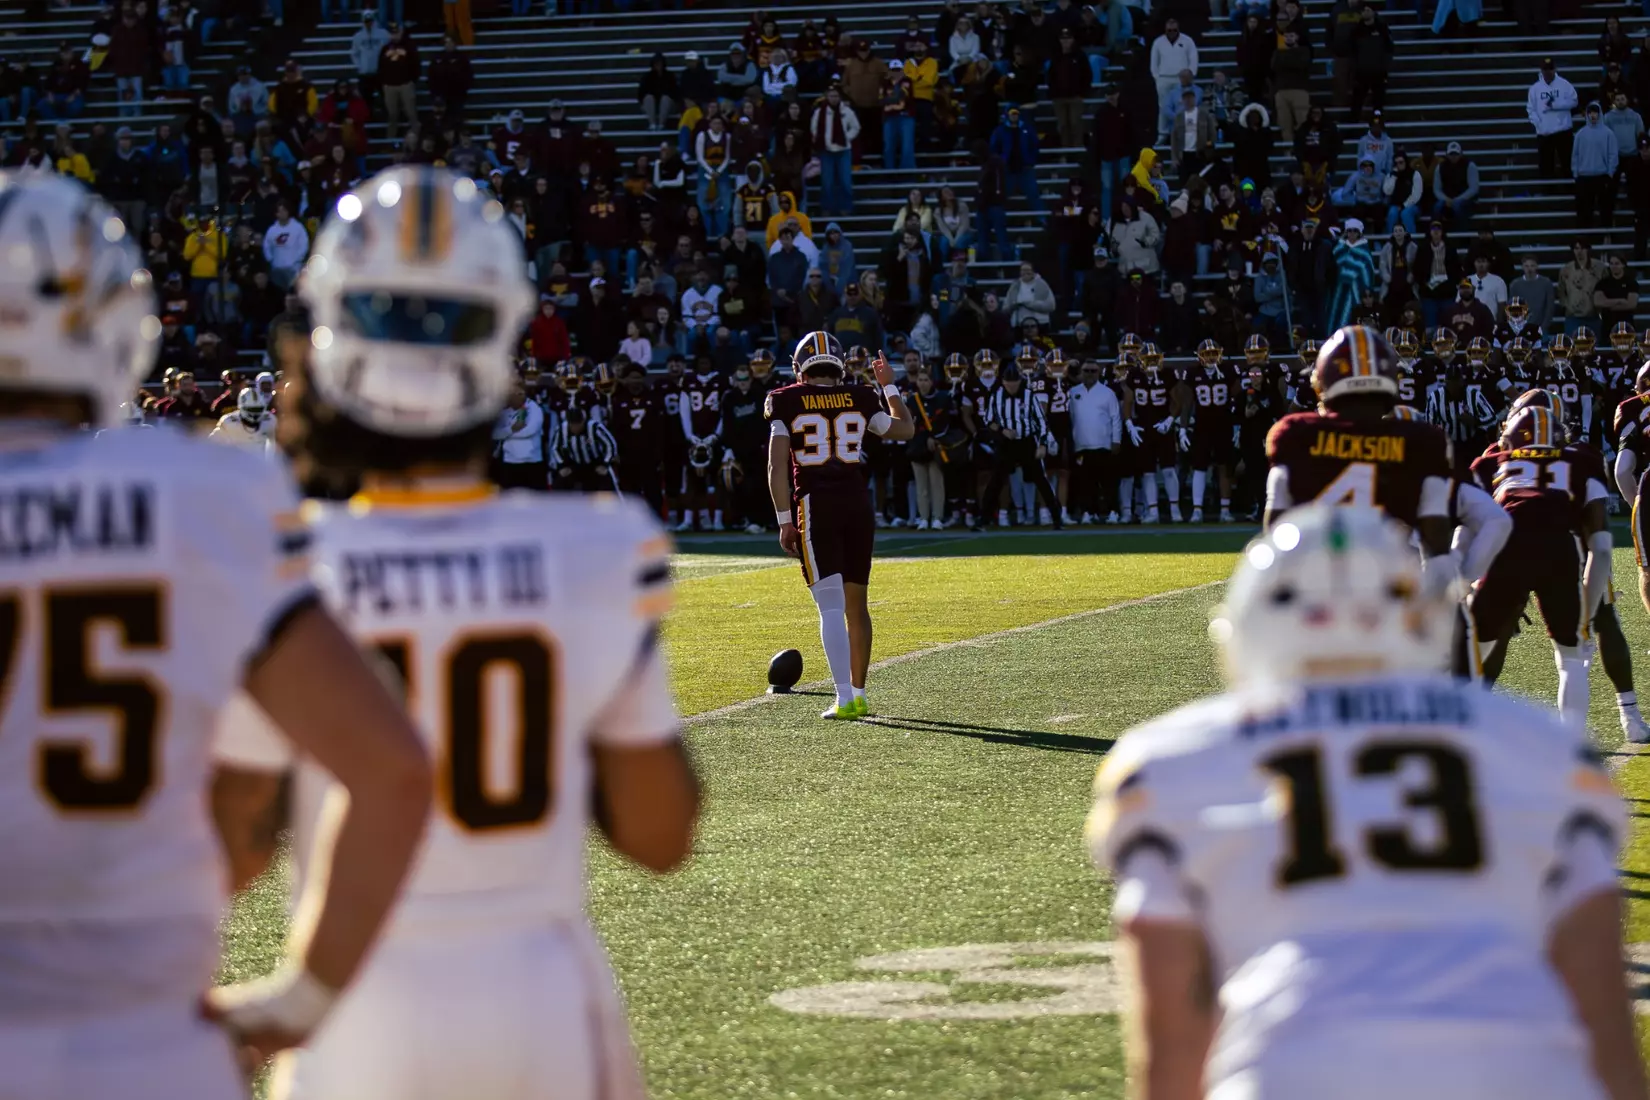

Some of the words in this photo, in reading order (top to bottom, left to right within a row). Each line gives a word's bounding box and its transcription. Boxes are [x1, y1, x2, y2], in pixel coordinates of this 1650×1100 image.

[629, 407, 648, 430] 7
[801, 393, 854, 410] VANHUIS
[791, 411, 867, 467] 38
[1309, 430, 1406, 463] JACKSON
[1314, 461, 1386, 515] 4
[0, 580, 165, 812] 5
[366, 627, 560, 832] 0
[1258, 735, 1485, 882] 13
